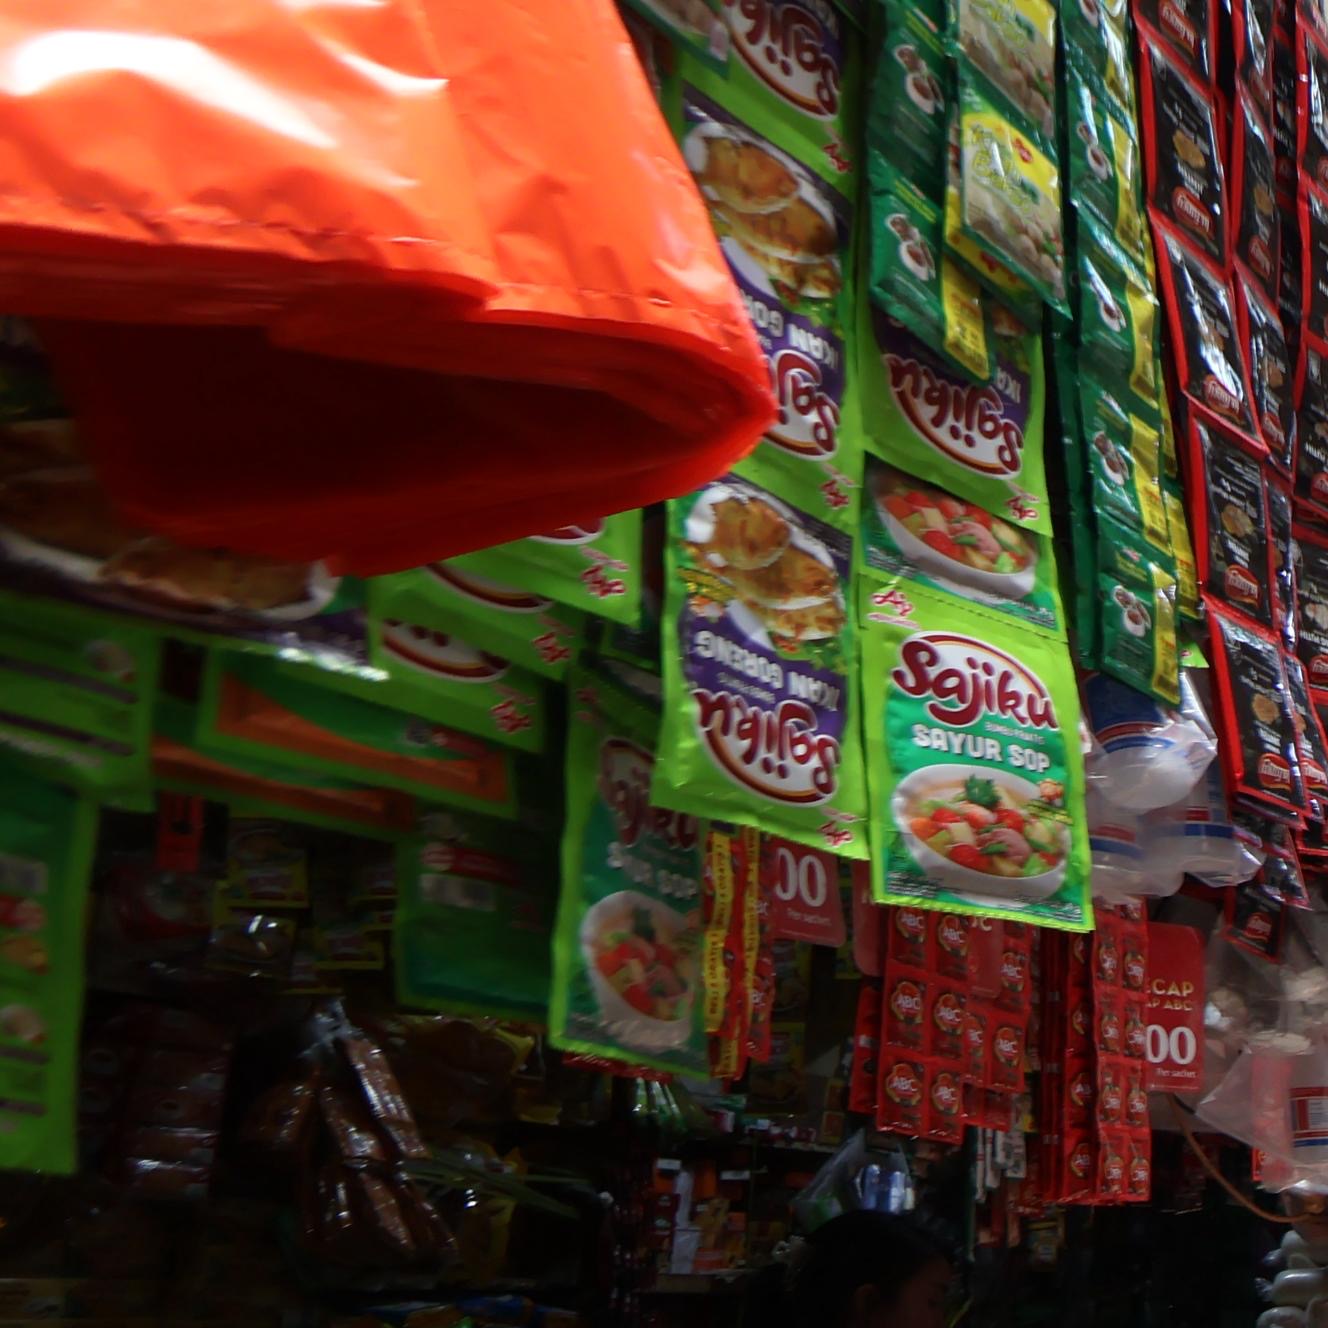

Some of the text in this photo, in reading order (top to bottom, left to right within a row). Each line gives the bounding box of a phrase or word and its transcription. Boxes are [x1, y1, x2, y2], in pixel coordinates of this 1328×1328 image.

[788, 323, 840, 371] IKAN
[883, 353, 1025, 472] Sajiku
[692, 630, 784, 689] GORENG
[892, 638, 1059, 729] Sajiku
[787, 670, 842, 712] IKAN
[692, 688, 841, 795] Sajiku
[911, 723, 1051, 774] SAYUR SOP
[896, 993, 921, 1010] ABC
[939, 1007, 962, 1023] ABC
[997, 1039, 1019, 1054] ABC
[890, 1076, 919, 1091] ABC
